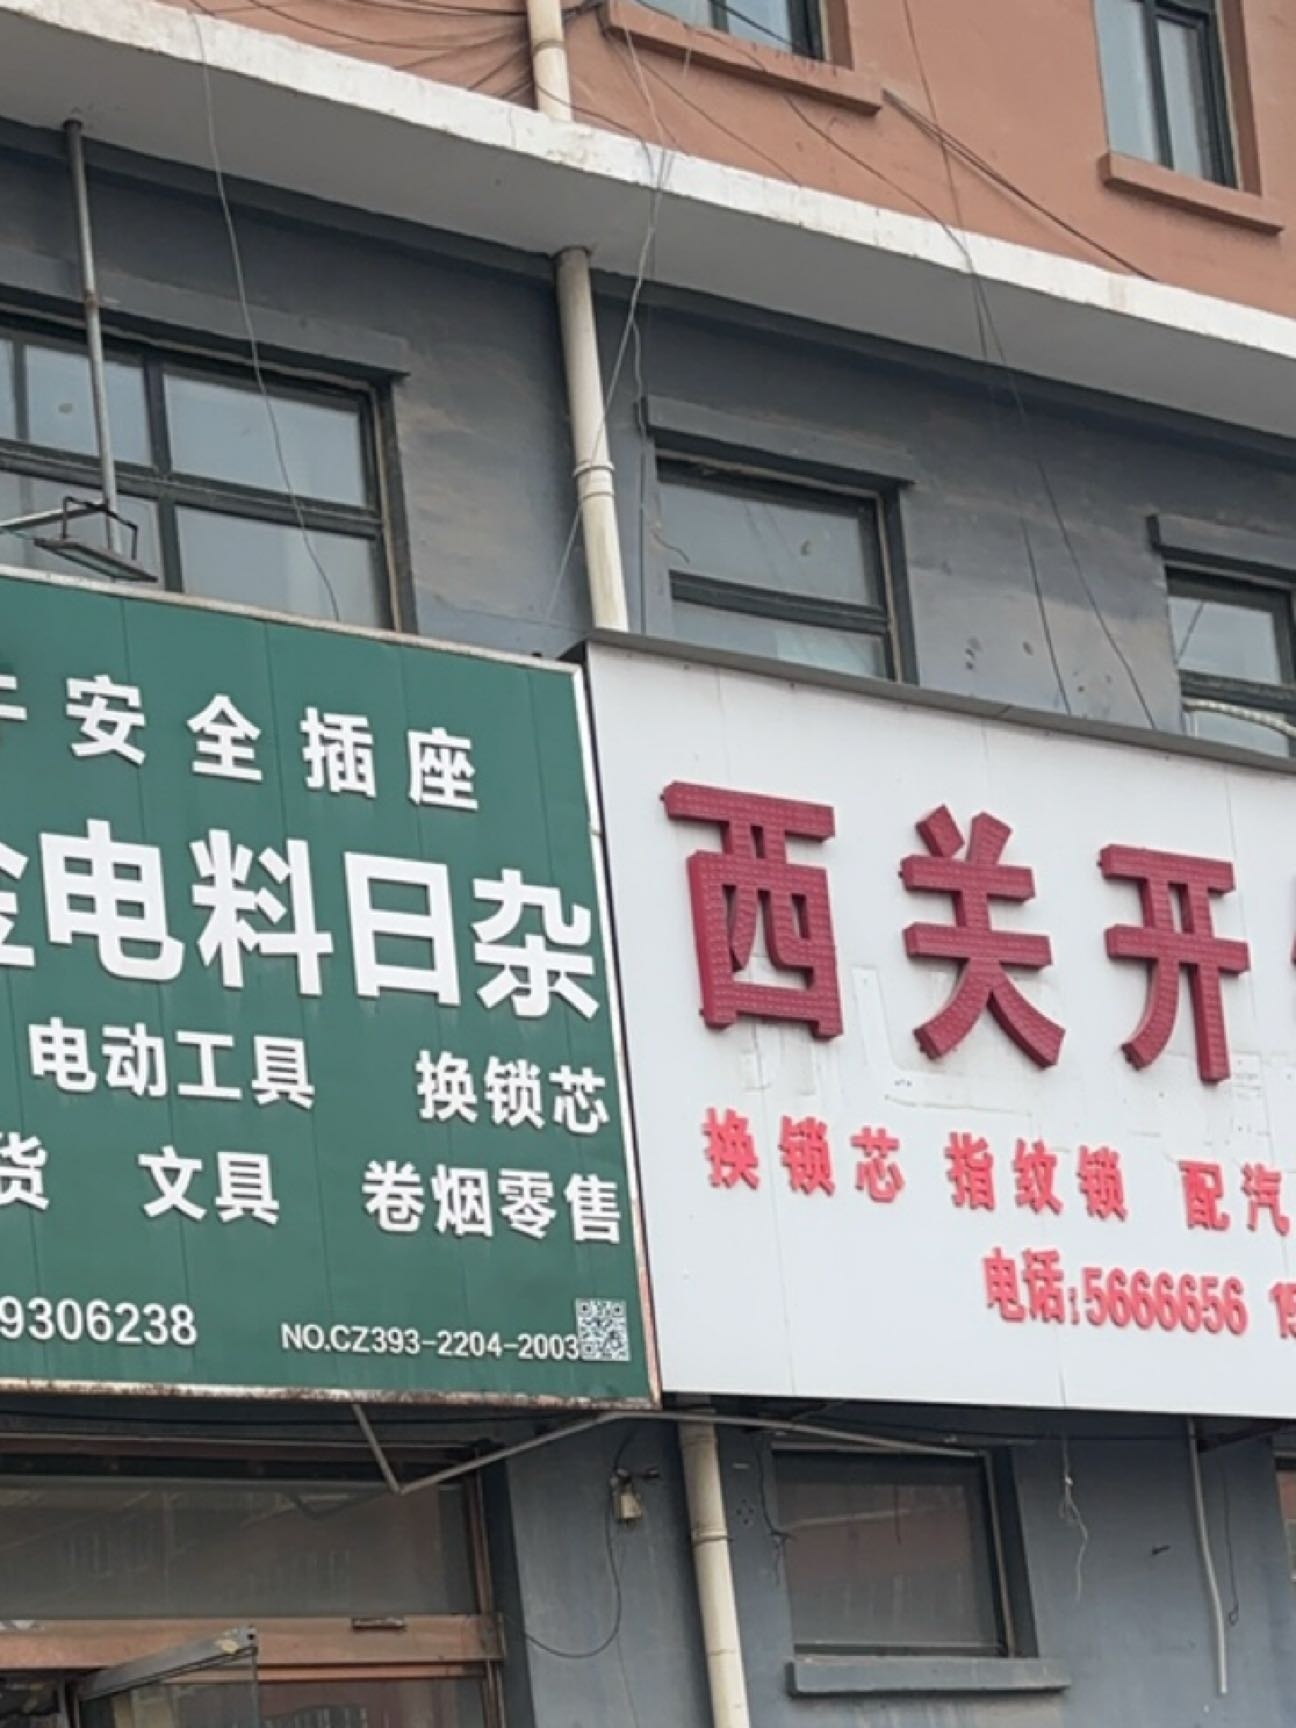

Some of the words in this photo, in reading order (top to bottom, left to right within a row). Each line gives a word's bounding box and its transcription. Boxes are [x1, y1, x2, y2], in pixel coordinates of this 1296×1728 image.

[660, 781, 1296, 1085] 西关开
[27, 1018, 316, 1110] 电动工具
[415, 1050, 609, 1136] 换锁芯
[137, 1146, 280, 1226] 文具
[361, 1160, 623, 1246] 卷烟零售
[702, 1108, 905, 1203] 换锁芯
[944, 1132, 1128, 1222] 指纹锁
[1179, 1160, 1291, 1237] 配汽
[280, 1323, 580, 1361] NO.CZ393-2204-2003
